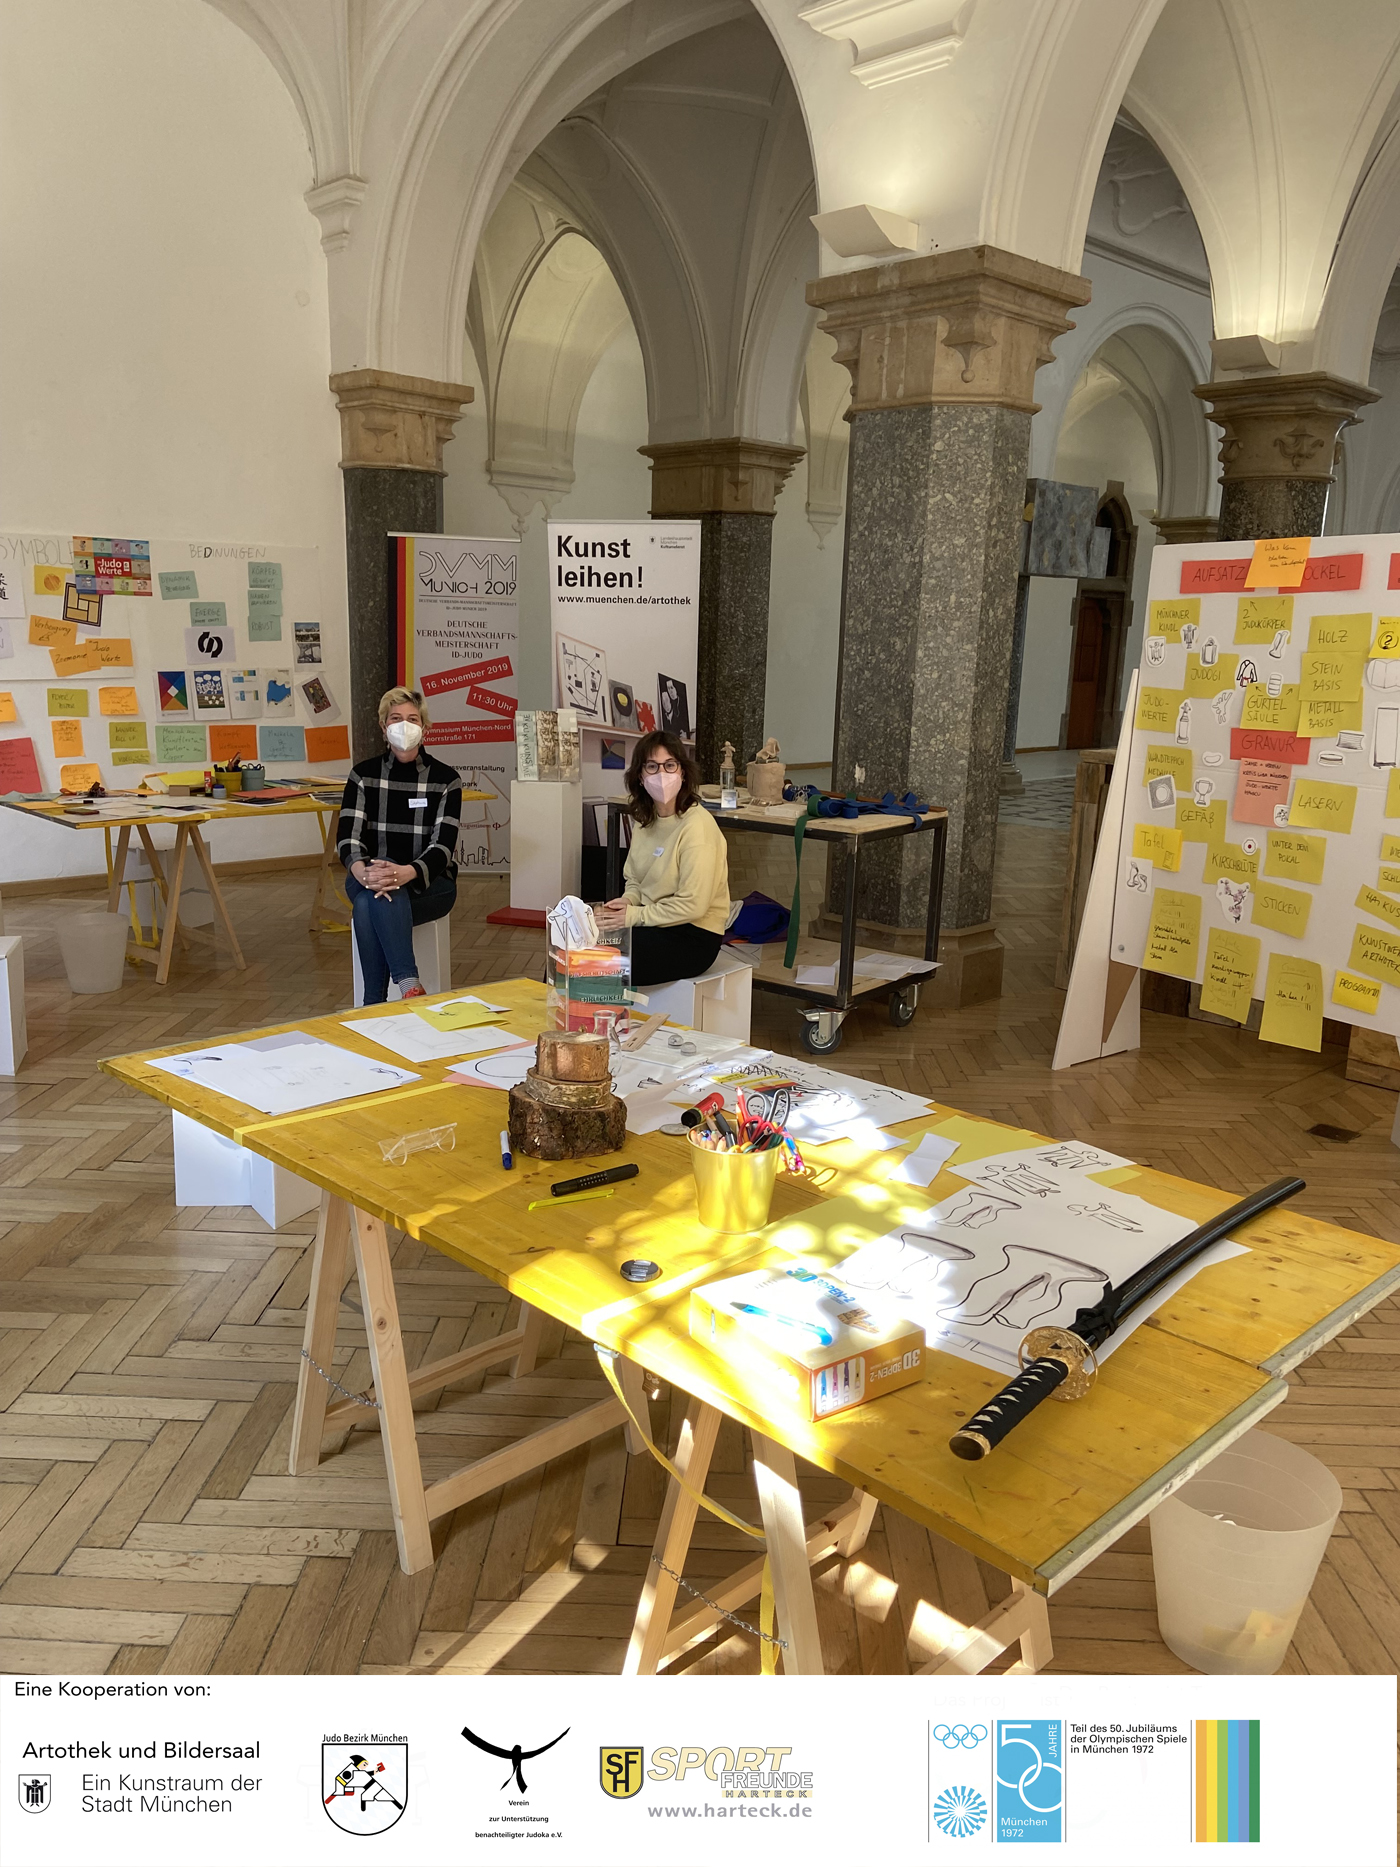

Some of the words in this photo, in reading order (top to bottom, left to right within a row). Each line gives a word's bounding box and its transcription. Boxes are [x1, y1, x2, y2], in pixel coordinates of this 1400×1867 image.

[189, 543, 266, 559] BEDINUNGEN
[557, 535, 631, 558] Kunst
[98, 566, 122, 575] Werte
[100, 559, 122, 568] Judo
[557, 565, 643, 588] leihen!
[1192, 565, 1246, 582] AUFSATZ
[1303, 564, 1346, 581] OCKEL
[485, 581, 517, 595] 2019
[557, 595, 692, 605] www.muenchen.de/artothek
[1156, 607, 1190, 620] MÜNCHNER
[1242, 608, 1251, 619] 2
[447, 620, 488, 629] DEUTSCHE
[1158, 623, 1179, 632] KINDL
[416, 629, 518, 641] VERBANDSMANNSCHAFTS-
[1318, 629, 1348, 644] HOLZ
[435, 640, 499, 650] MEISTERSCHAFT
[451, 651, 483, 659] ID-JUDO
[1190, 668, 1222, 681] JUDOGI
[1308, 661, 1344, 675] STEIN
[426, 681, 440, 690] 16.
[441, 669, 486, 687] November
[486, 662, 509, 675] 2019
[1313, 679, 1343, 692] BASIS
[472, 692, 496, 706] 11:30
[497, 700, 514, 712] Uhr
[1247, 694, 1288, 711] GÜRTEL
[1308, 701, 1345, 715] METALL
[1141, 710, 1168, 722] WERTE
[1246, 710, 1280, 724] SÄULE
[423, 727, 460, 736] ymnasium
[461, 723, 512, 732] München-Nord
[1308, 718, 1335, 729] BASIS
[1241, 734, 1296, 752] GRAVUR
[1298, 794, 1344, 812] LASERN
[1140, 830, 1165, 850] Tafel
[1271, 840, 1294, 850] UNTER
[1211, 852, 1258, 874] KIRSCHBLÜTE
[1277, 853, 1301, 864] POKAL
[1260, 896, 1301, 916] STICKEN
[1338, 977, 1380, 998] PROGRAMM
[902, 1348, 921, 1370] 3D
[869, 1361, 902, 1383] 3DPEN-2
